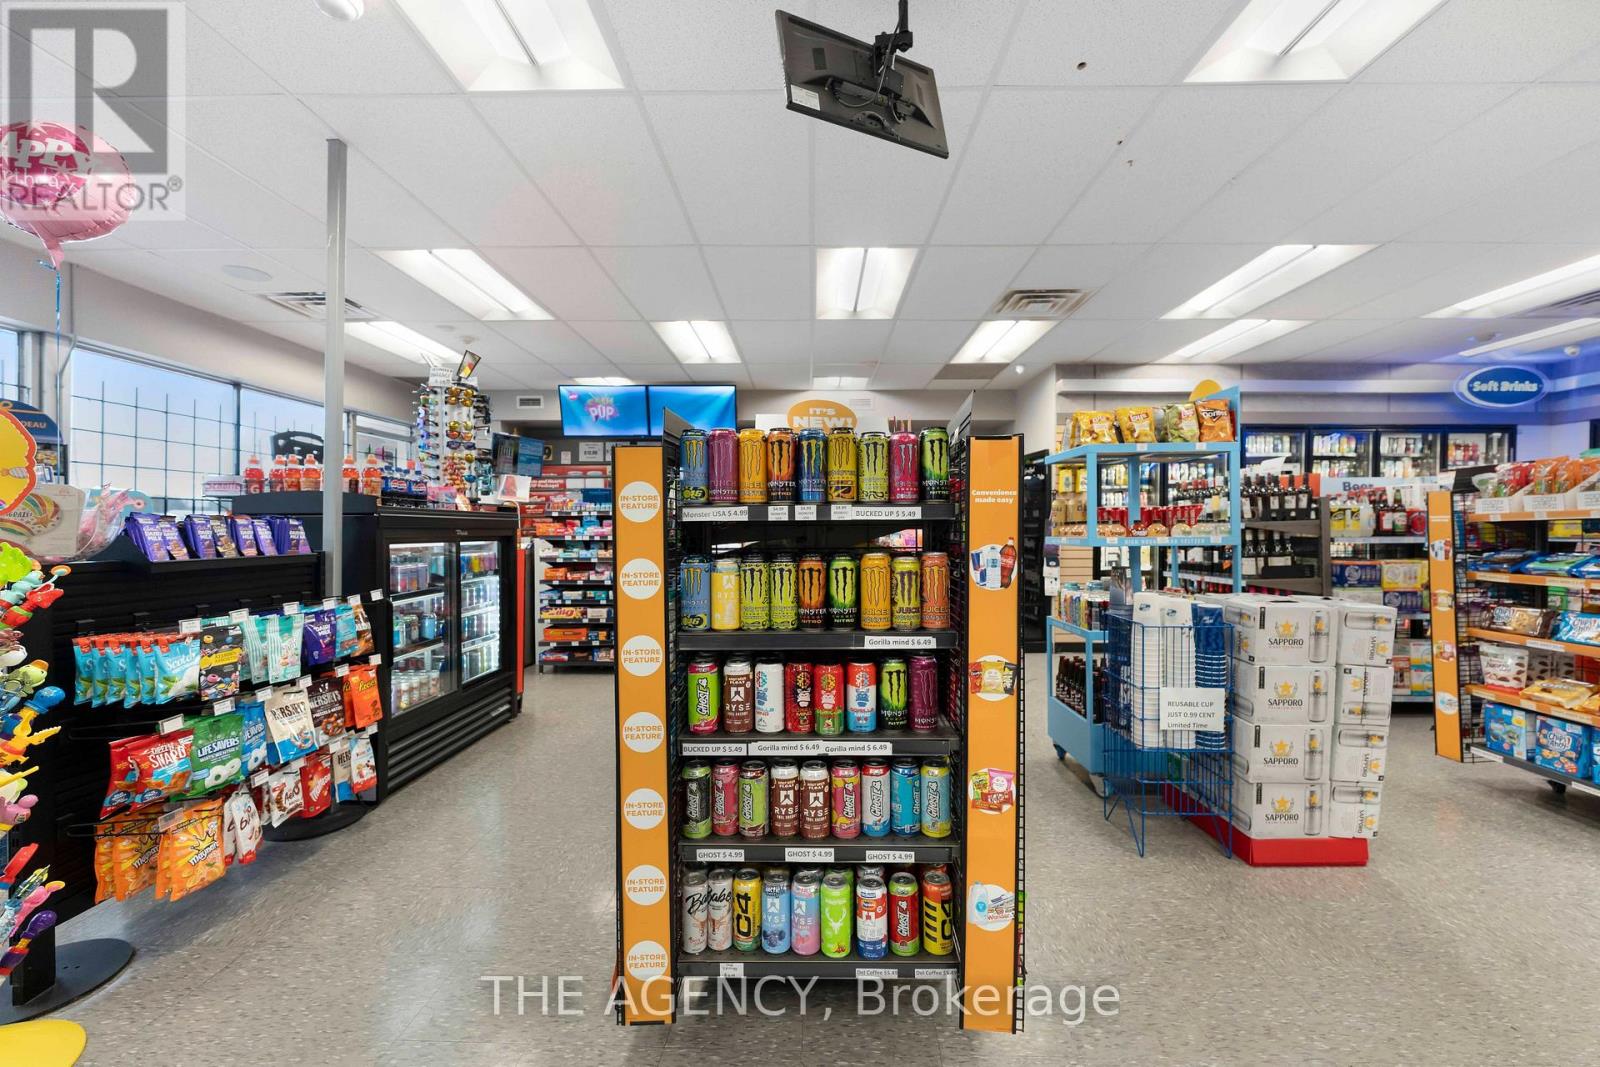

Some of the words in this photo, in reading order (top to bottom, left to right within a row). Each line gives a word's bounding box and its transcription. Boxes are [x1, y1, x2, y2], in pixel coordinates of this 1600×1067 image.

[1472, 380, 1499, 391] Soft
[1500, 380, 1538, 391] Drinks
[1268, 638, 1304, 646] SAPPORO
[167, 652, 198, 670] Scotch
[725, 702, 751, 711] RYSE
[1263, 757, 1299, 765] SAPPORO
[774, 805, 799, 815] RYSE
[804, 807, 829, 817] RYSE
[736, 892, 752, 937] C4
